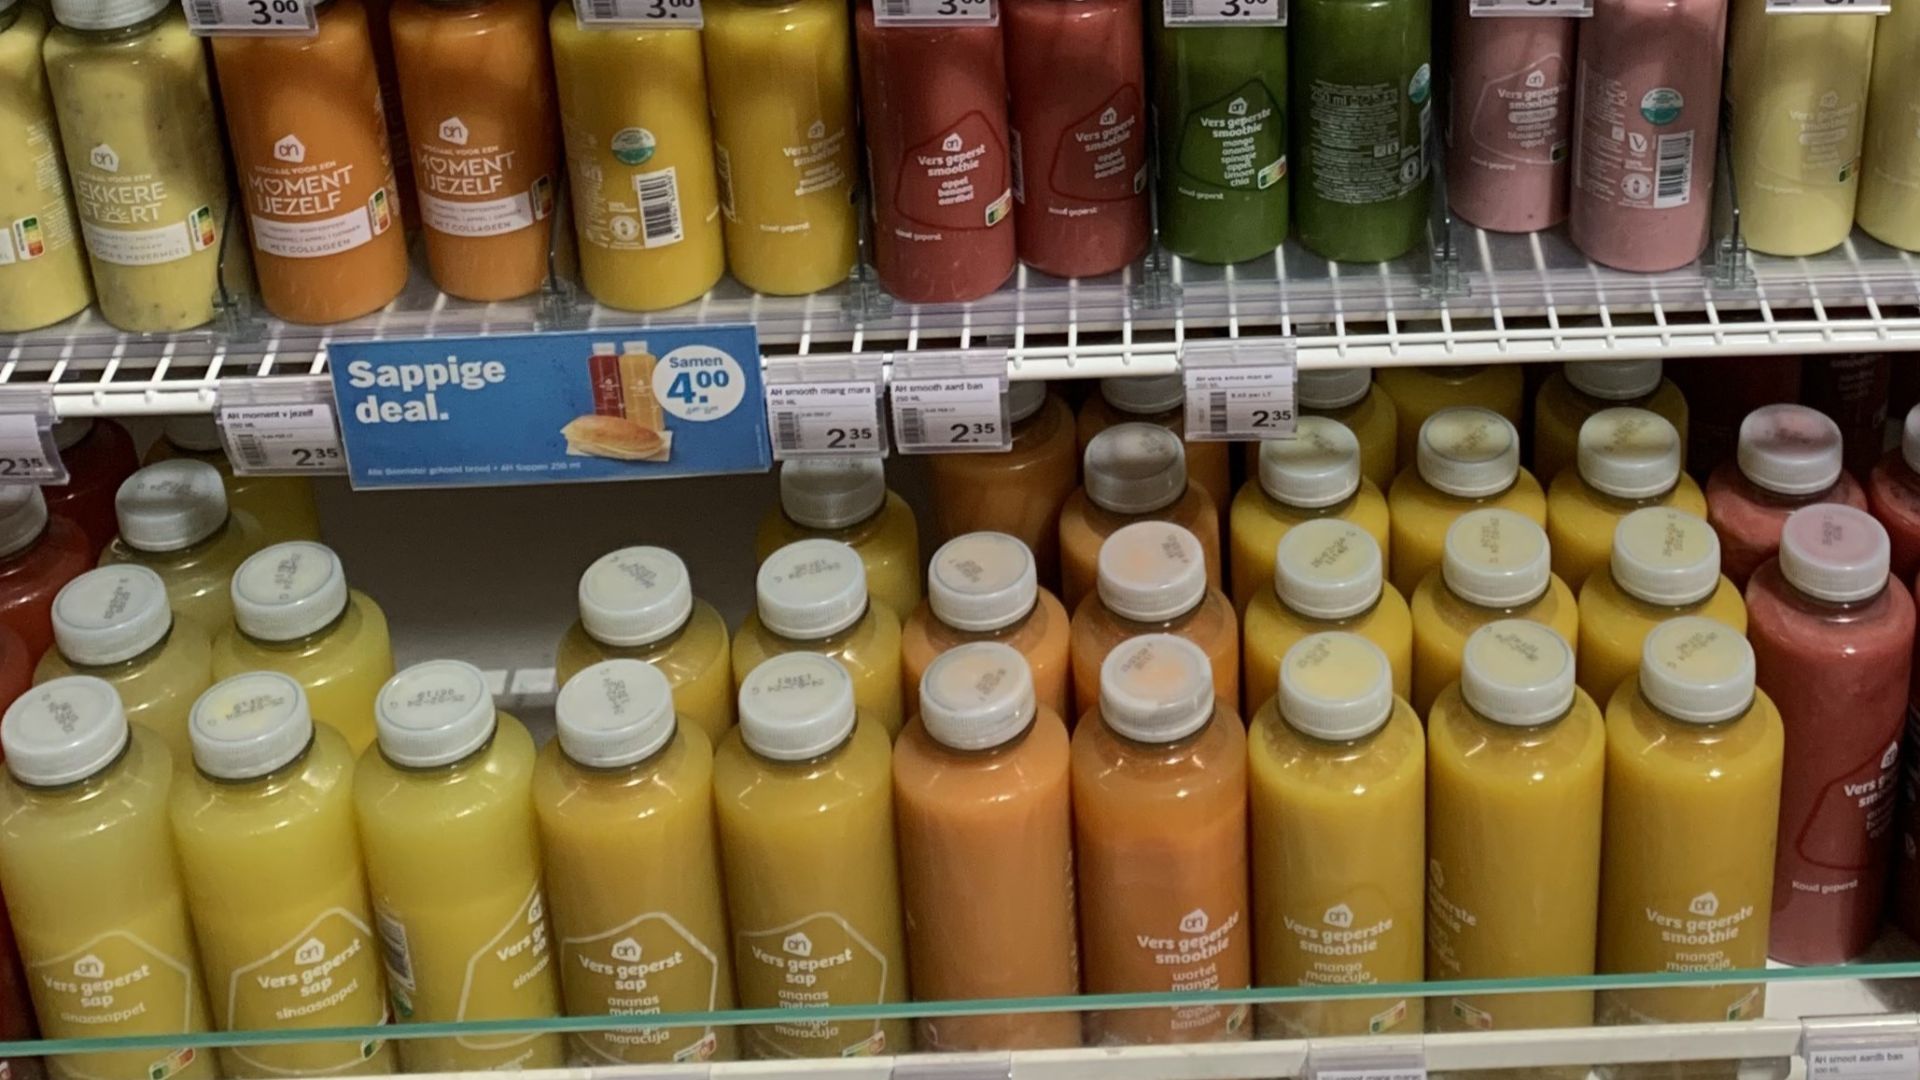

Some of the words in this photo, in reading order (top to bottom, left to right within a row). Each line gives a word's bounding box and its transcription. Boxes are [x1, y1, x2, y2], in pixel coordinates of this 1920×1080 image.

[248, 0, 299, 25] 3.00
[1497, 88, 1523, 99] Vers
[1200, 117, 1226, 127] Vers
[1212, 123, 1262, 138] smoothie
[1075, 132, 1100, 142] Vers
[1085, 130, 1131, 152] smoothie
[918, 156, 944, 166] Vers
[928, 160, 979, 176] smoothie
[1230, 178, 1250, 187] chia
[79, 181, 168, 205] EKKERE
[669, 356, 723, 369] Samen
[347, 355, 507, 392] Sappige
[667, 369, 729, 404] 4.00
[770, 388, 782, 396] AH
[785, 387, 818, 396] smooth
[820, 387, 846, 396] mang
[910, 384, 942, 392] smooth
[944, 383, 965, 391] aard
[242, 411, 280, 419] moment
[289, 408, 314, 419] jezelf
[355, 393, 450, 424] deal.
[1251, 409, 1291, 428] 2.35
[826, 427, 872, 449] 2.35
[950, 422, 996, 443] 2.35
[291, 447, 338, 466] 2.35
[501, 463, 514, 472] AH
[515, 463, 549, 473] Sappen
[550, 462, 567, 470] 250
[1843, 779, 1876, 797] Vers
[1792, 880, 1820, 893] Koud
[1821, 879, 1858, 895] geperst
[1645, 907, 1682, 929] Vers
[1686, 905, 1754, 934] geperste
[1136, 934, 1175, 950] Vers
[1178, 911, 1240, 953] geperste
[1283, 916, 1318, 939] Vers
[1322, 918, 1393, 945] geperste
[1661, 926, 1740, 945] smoothie
[496, 935, 531, 961] Vers
[1155, 937, 1230, 965] smoothie
[1300, 940, 1378, 956] smoothie
[257, 973, 298, 989] Vers
[301, 938, 361, 985] geperst
[578, 953, 614, 975] Vers
[617, 951, 684, 979] geperst
[751, 945, 785, 968] Vers
[788, 948, 853, 973] geperst
[1314, 961, 1362, 973] mango
[1675, 951, 1724, 965] mango
[42, 974, 78, 993] Vers
[81, 963, 150, 996] geperst
[785, 973, 816, 987] sap
[1172, 962, 1217, 981] wortel
[1306, 969, 1371, 985] maracuja
[300, 977, 333, 997] sap
[615, 979, 647, 993] sap
[1172, 974, 1219, 992] mango
[80, 995, 113, 1008] sap
[276, 979, 359, 1021] sinaasappel
[608, 995, 659, 1006] ananas
[778, 990, 829, 1001] ananas
[61, 1002, 147, 1024] sinaasappel
[604, 1029, 670, 1045] maracuja
[775, 1025, 840, 1040] maracuja
[1815, 1055, 1827, 1064] AH
[1887, 1052, 1904, 1060] ban
